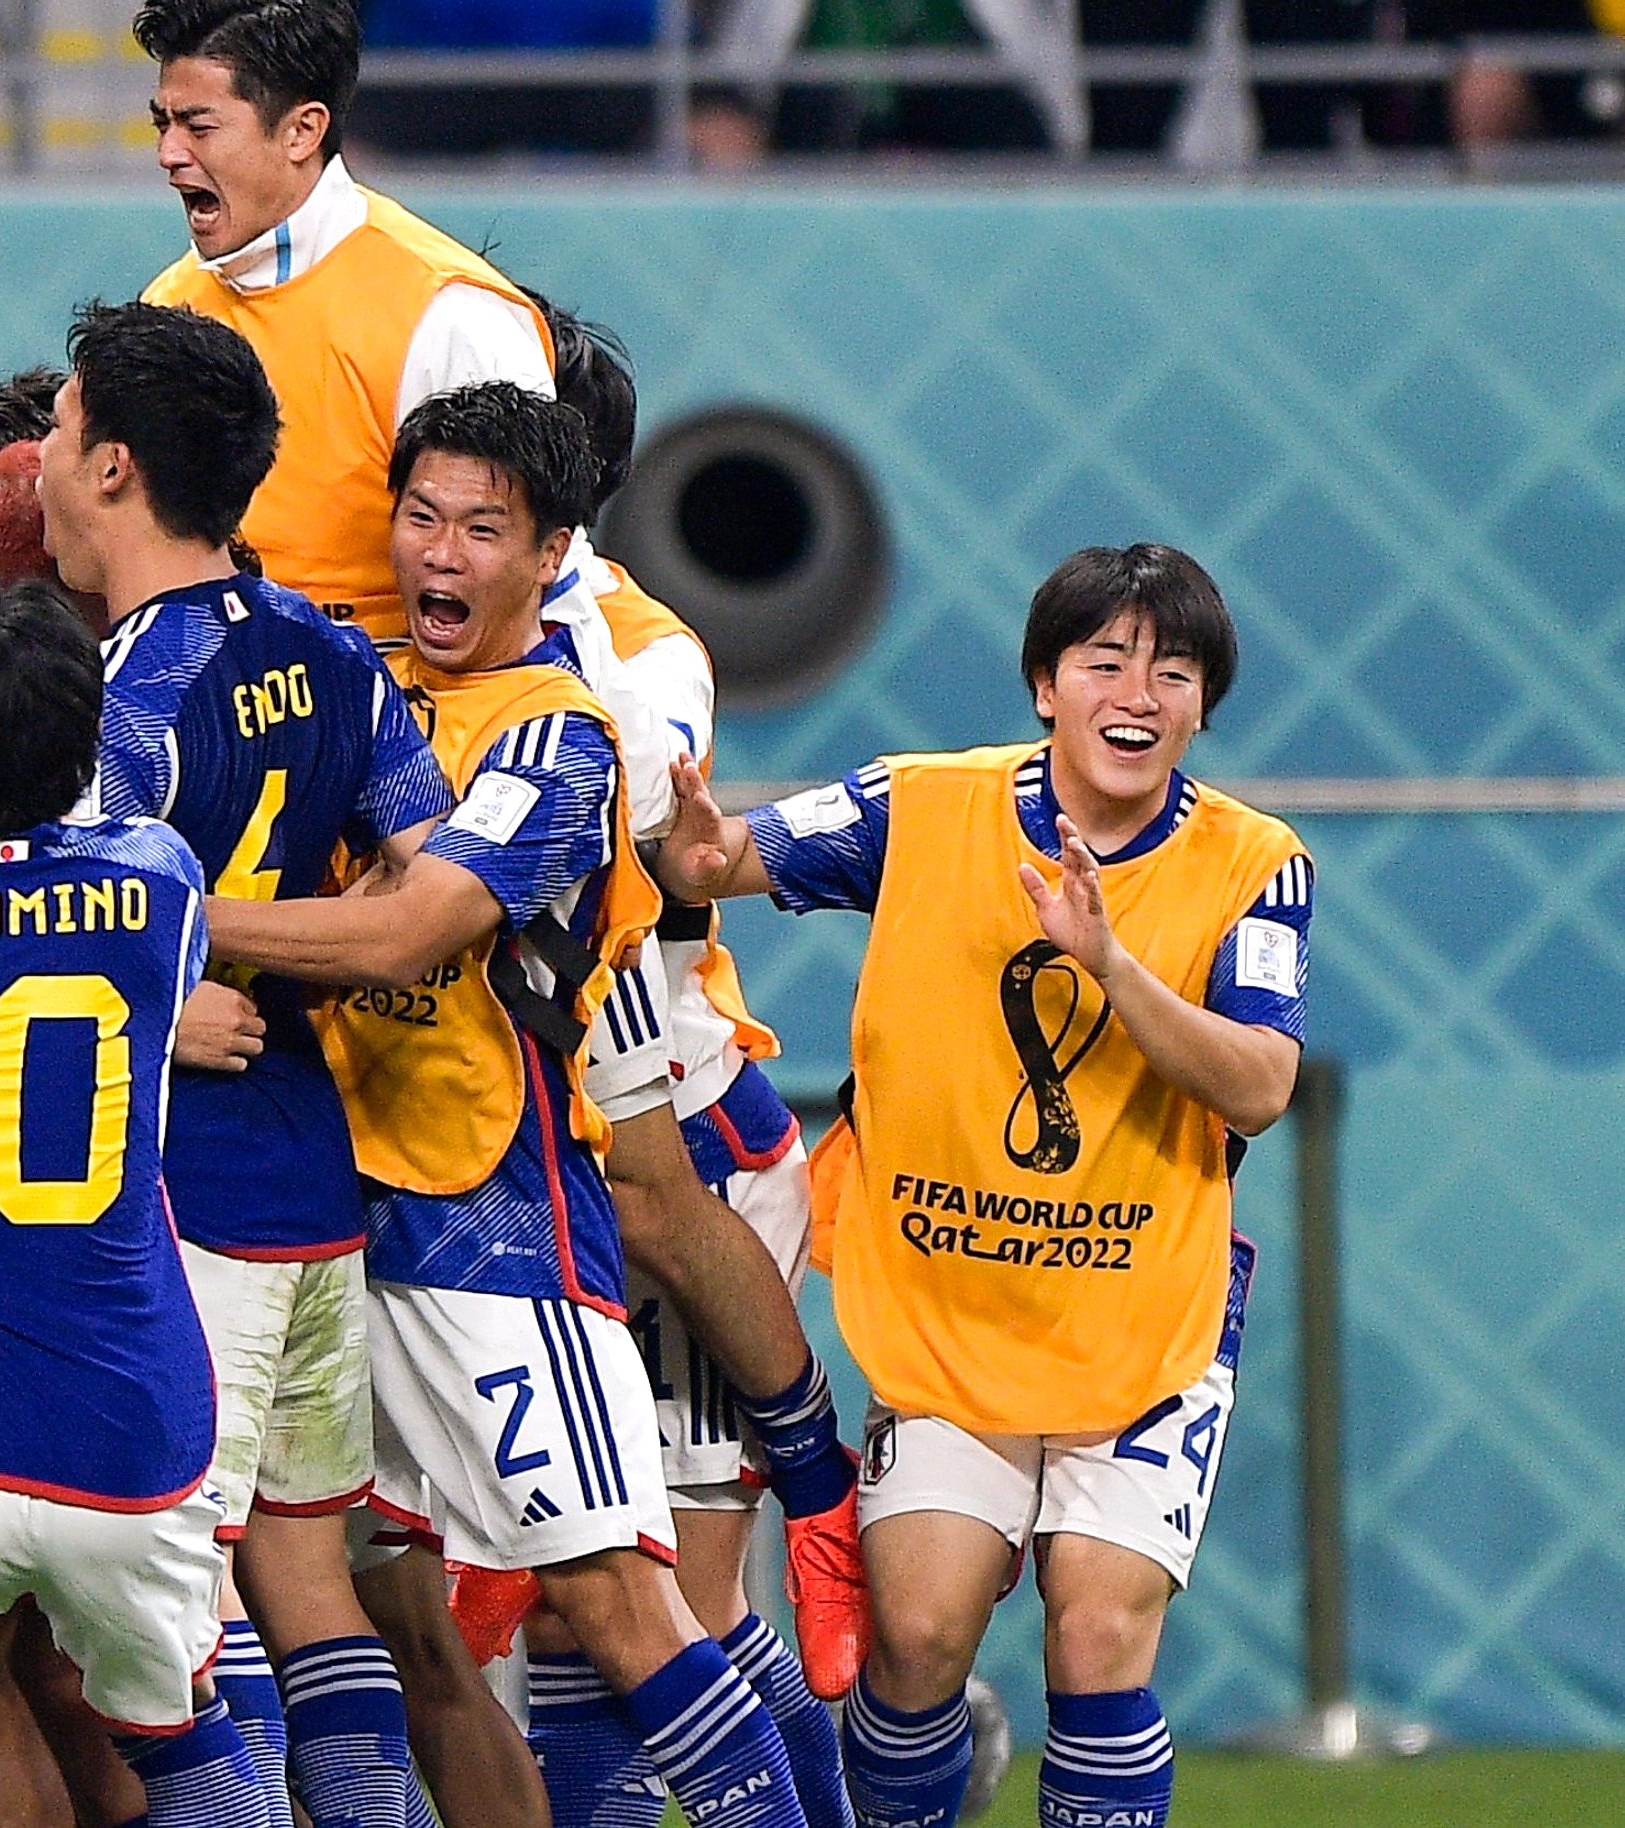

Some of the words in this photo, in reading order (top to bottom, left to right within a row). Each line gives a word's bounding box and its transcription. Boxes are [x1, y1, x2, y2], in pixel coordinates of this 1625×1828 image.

[233, 664, 313, 738] ENDO
[892, 1174, 967, 1215] FIFA
[975, 1190, 1093, 1229] WORLD
[1098, 1203, 1154, 1230] CUP
[475, 1365, 552, 1479] 2
[1112, 1393, 1221, 1498] 24
[1043, 1801, 1154, 1828] JAPAN
